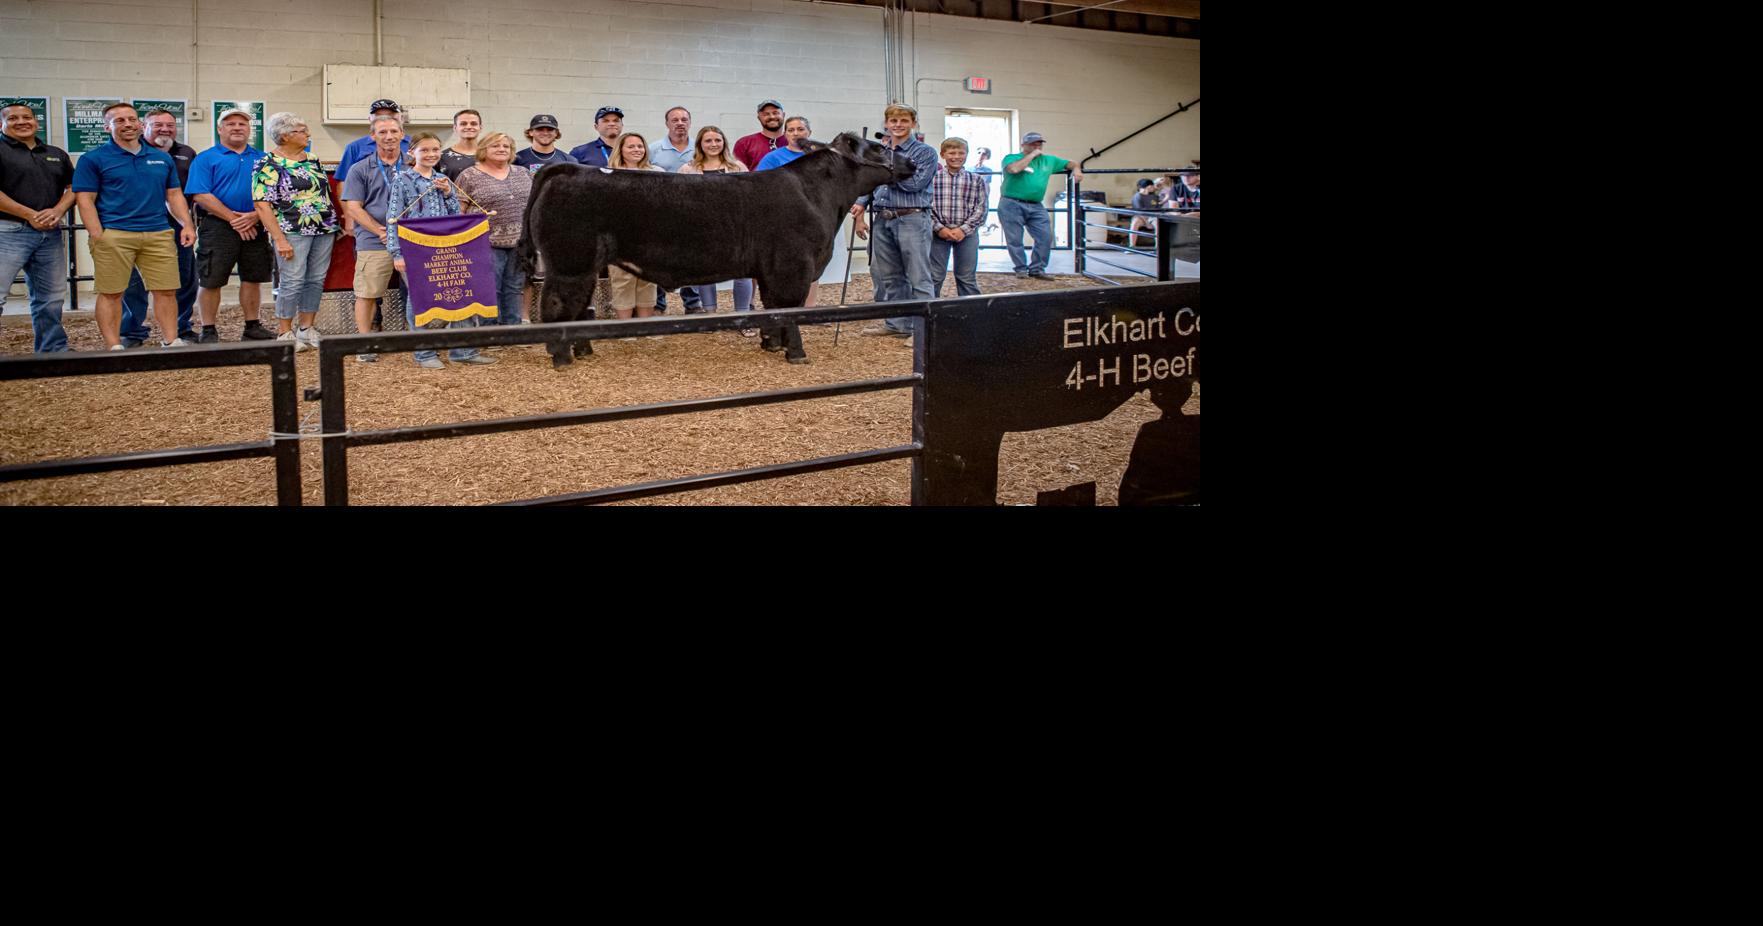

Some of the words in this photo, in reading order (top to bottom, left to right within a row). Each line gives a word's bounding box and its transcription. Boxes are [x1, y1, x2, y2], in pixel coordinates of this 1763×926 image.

[431, 253, 463, 261] CHAMPION
[424, 260, 448, 268] MARKET
[431, 267, 448, 275] BEEF
[428, 273, 459, 282] ELKHART
[1063, 311, 1167, 349] Elkhart
[1065, 356, 1120, 390] 4-H
[1133, 347, 1196, 383] Beef
